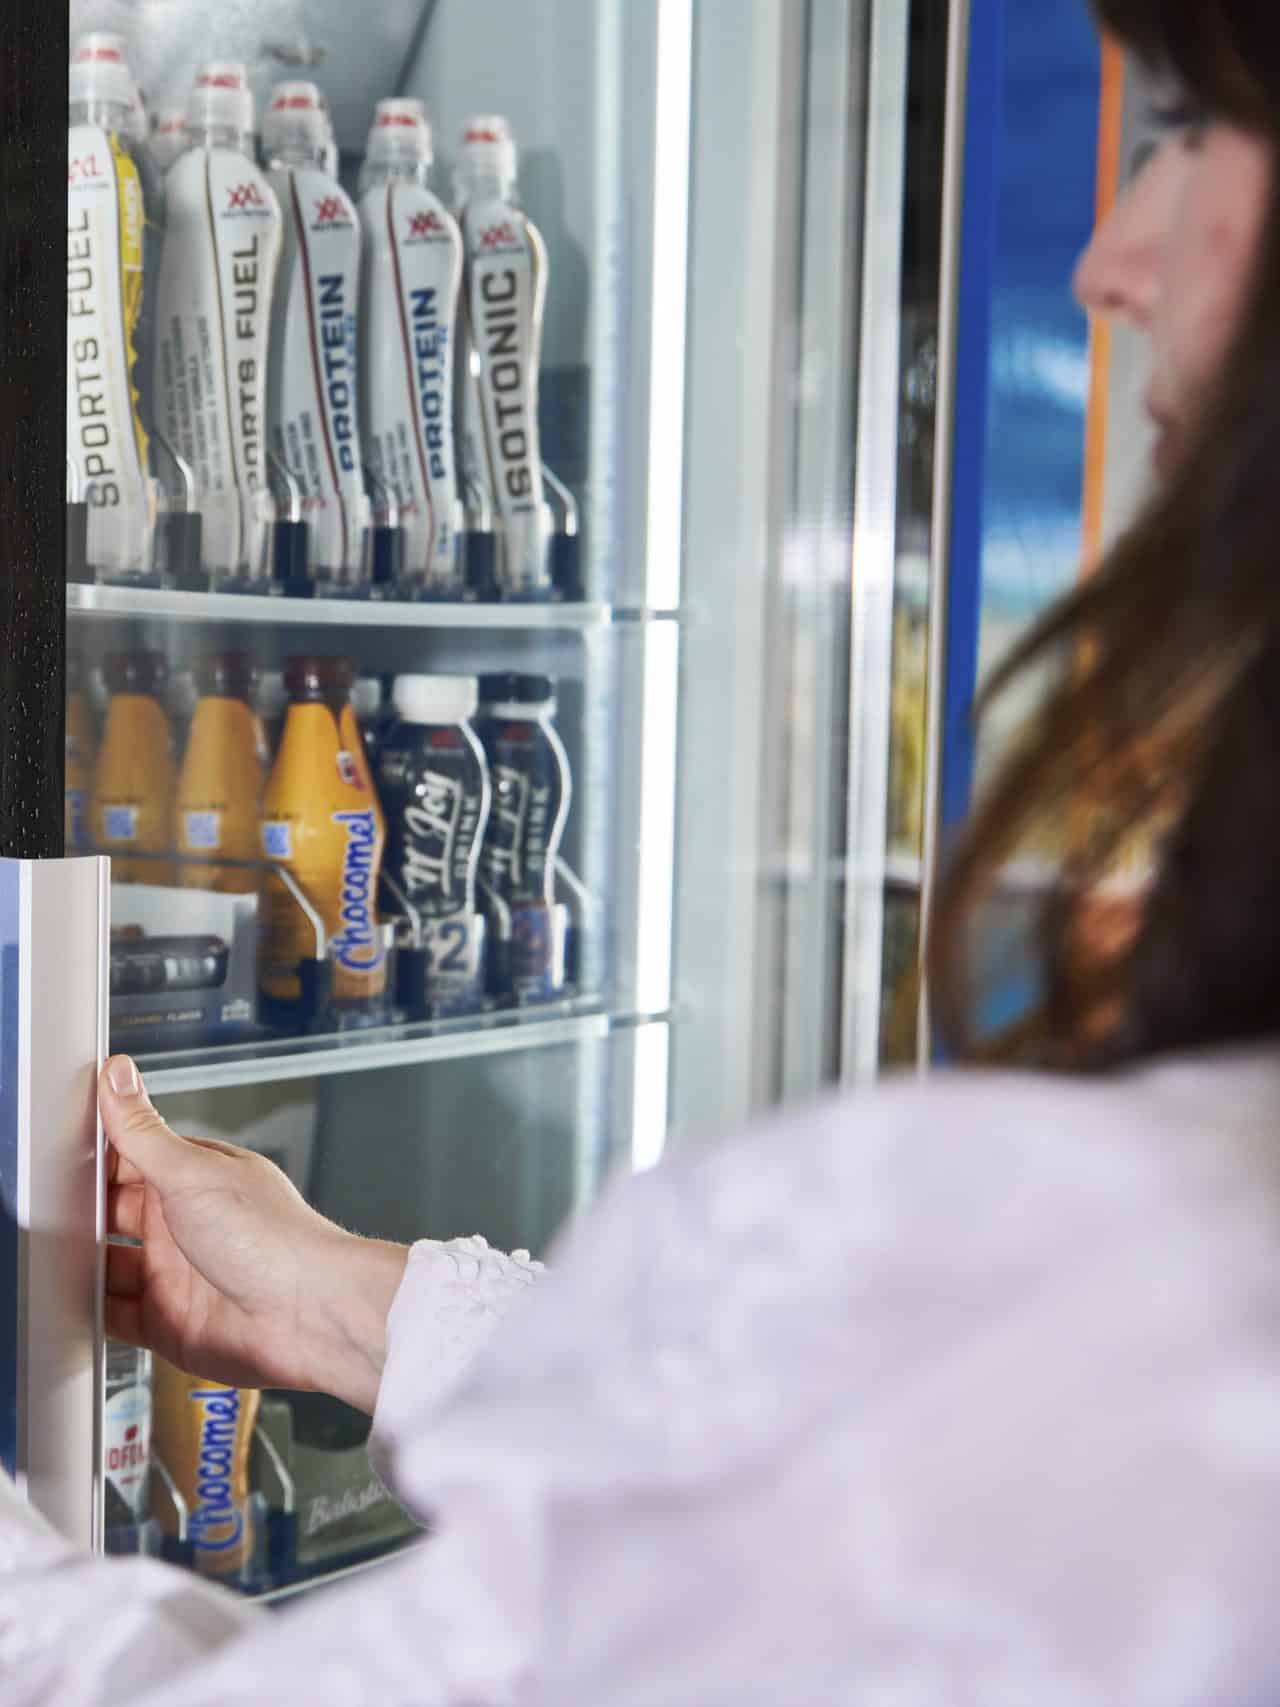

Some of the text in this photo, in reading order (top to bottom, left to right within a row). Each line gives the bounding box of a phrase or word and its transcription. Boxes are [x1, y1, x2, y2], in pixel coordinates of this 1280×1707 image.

[232, 234, 258, 340] FUEL
[74, 337, 120, 508] SPORTS
[318, 273, 355, 473] PROTEIN
[410, 287, 447, 480] PROTEIN
[481, 268, 535, 514] ISOTONIC
[331, 809, 382, 972] Chocomel
[188, 1387, 244, 1551] Chocomel
